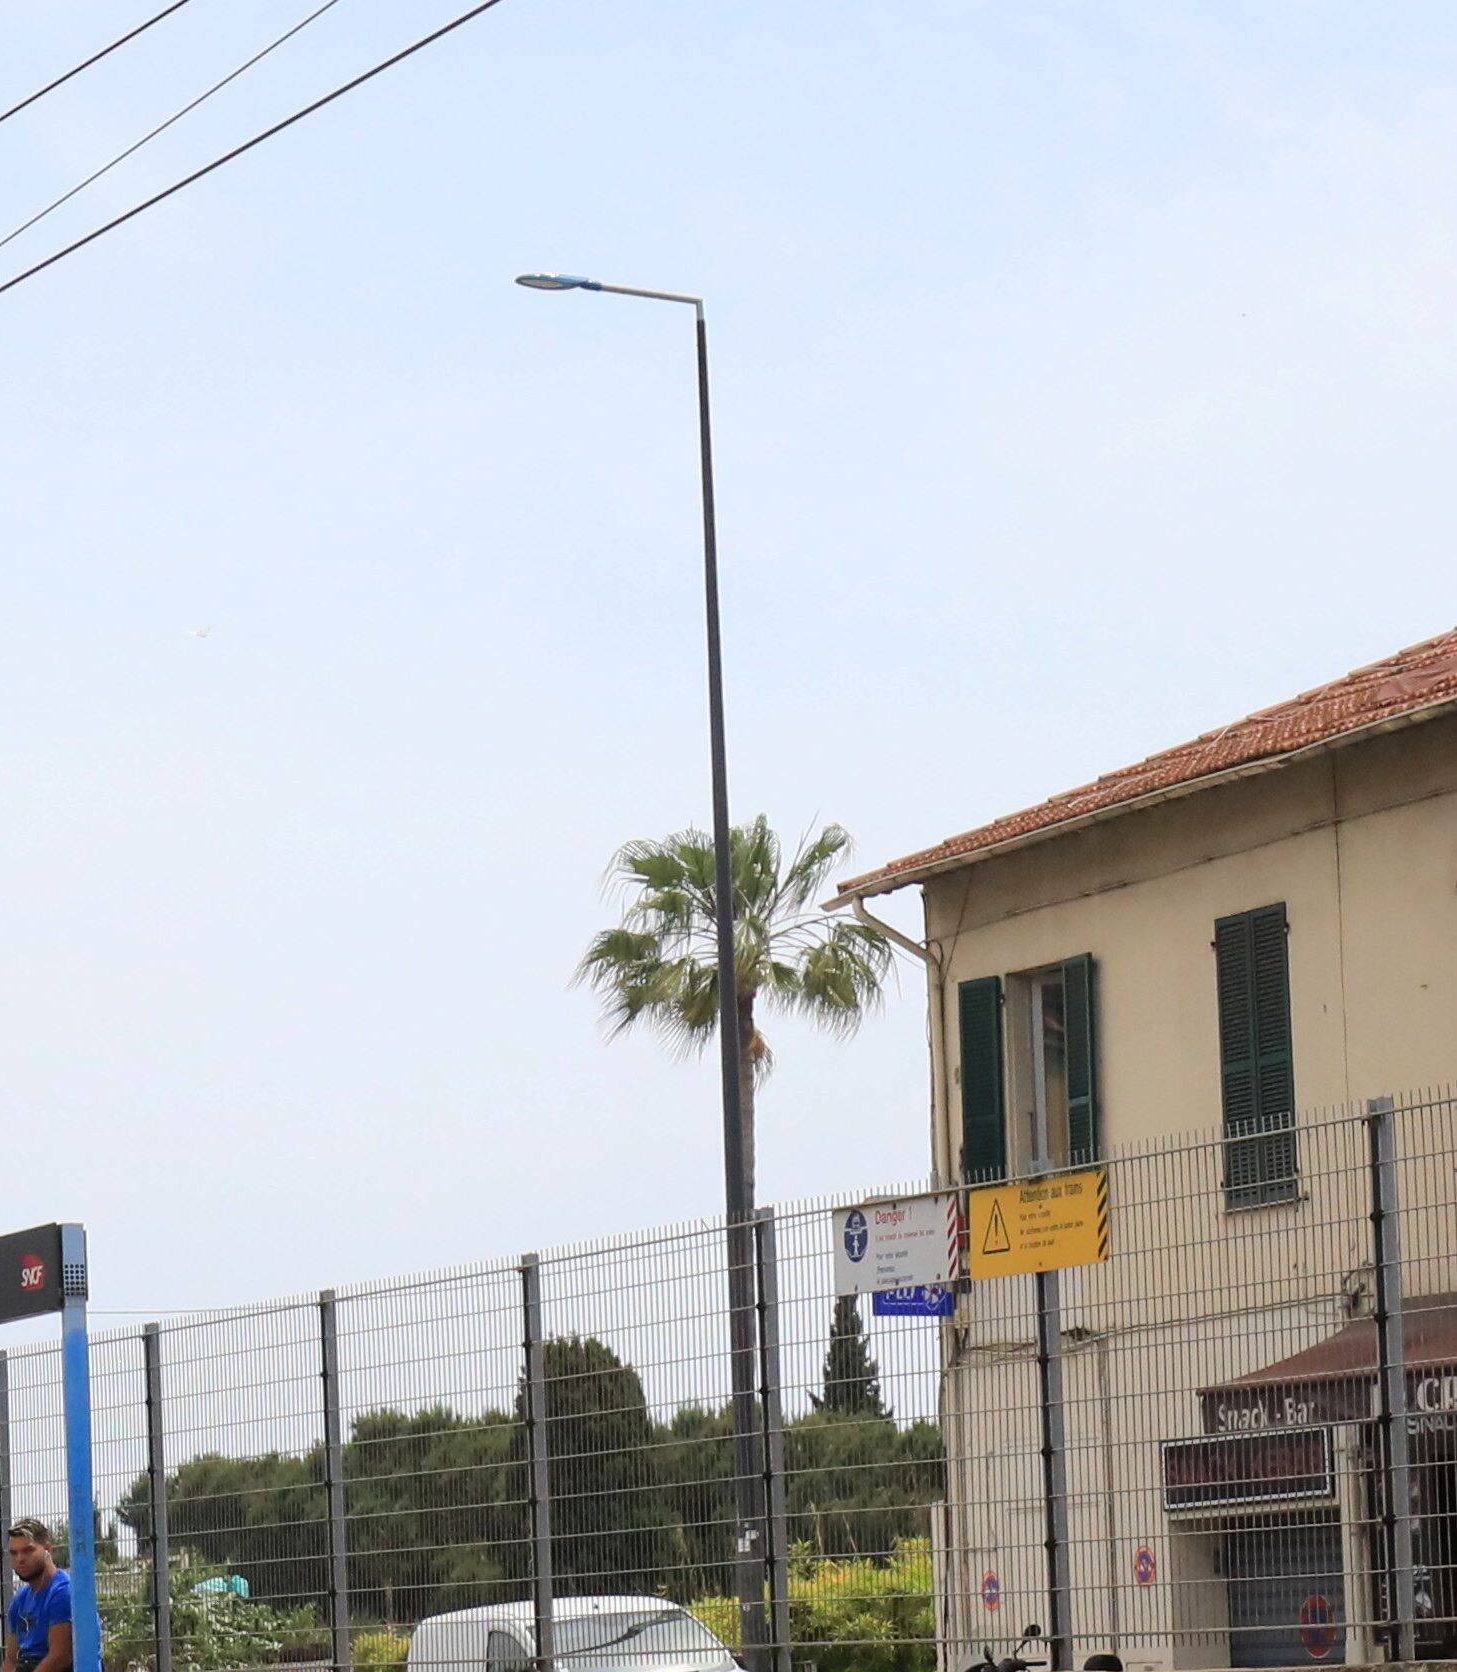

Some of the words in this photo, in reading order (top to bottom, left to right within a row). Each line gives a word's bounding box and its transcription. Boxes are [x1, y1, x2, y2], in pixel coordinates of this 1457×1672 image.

[21, 1265, 44, 1288] SNCF
[1218, 1399, 1267, 1431] Snack
[1284, 1397, 1316, 1425] Bar
